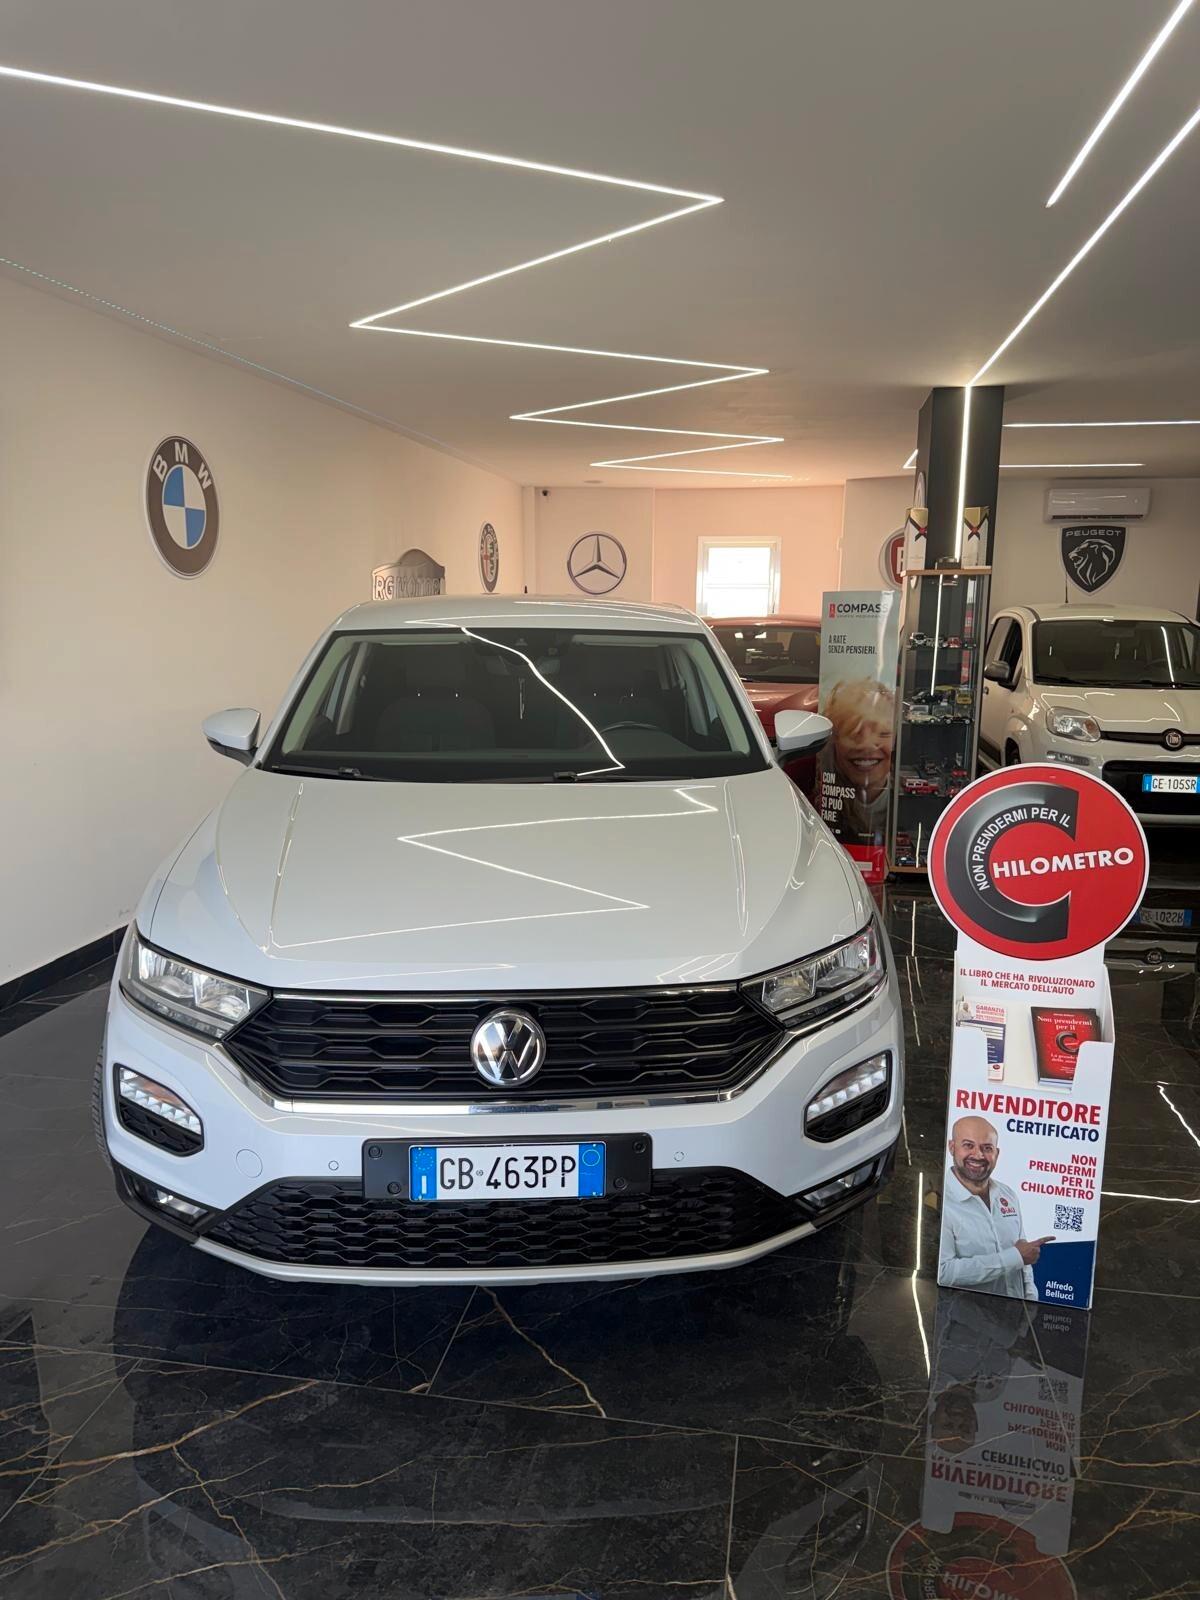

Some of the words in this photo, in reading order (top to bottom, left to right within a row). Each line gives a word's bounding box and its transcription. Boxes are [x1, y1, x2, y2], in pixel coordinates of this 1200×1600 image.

[153, 441, 212, 490] BMW
[1065, 528, 1123, 538] PEUGEOT
[828, 645, 844, 654] SENZA
[822, 772, 836, 784] CON
[1152, 778, 1164, 790] GE
[1168, 779, 1197, 791] 105SR
[822, 784, 856, 799] COMPASS
[821, 796, 828, 808] SI
[1031, 806, 1059, 820] PER
[1059, 813, 1071, 828] IL
[972, 807, 1028, 862] PRENDERMI
[992, 847, 1134, 879] HILOMETRO
[972, 864, 990, 891] NON
[960, 968, 967, 976] IL
[969, 969, 993, 979] LIBRO
[995, 972, 1011, 981] CHE
[1013, 973, 1025, 982] HA
[1028, 974, 1096, 989] RIVOLUZIONATO
[991, 980, 1030, 991] MERCATO
[1032, 984, 1075, 996] DELL'AUTO
[956, 1089, 1102, 1126] RIVENDITORE
[1006, 1118, 1100, 1143] CERTIFICATO
[1071, 1154, 1097, 1167] NON
[439, 1157, 474, 1190] GB
[486, 1156, 577, 1190] 463PP
[1029, 1160, 1096, 1178] PRENDERMI
[1061, 1175, 1082, 1188] PER
[1085, 1177, 1096, 1190] IL
[1021, 1181, 1094, 1201] CHILOMETRO
[1045, 1280, 1074, 1292] Alfredo
[1045, 1288, 1075, 1301] Bellucci
